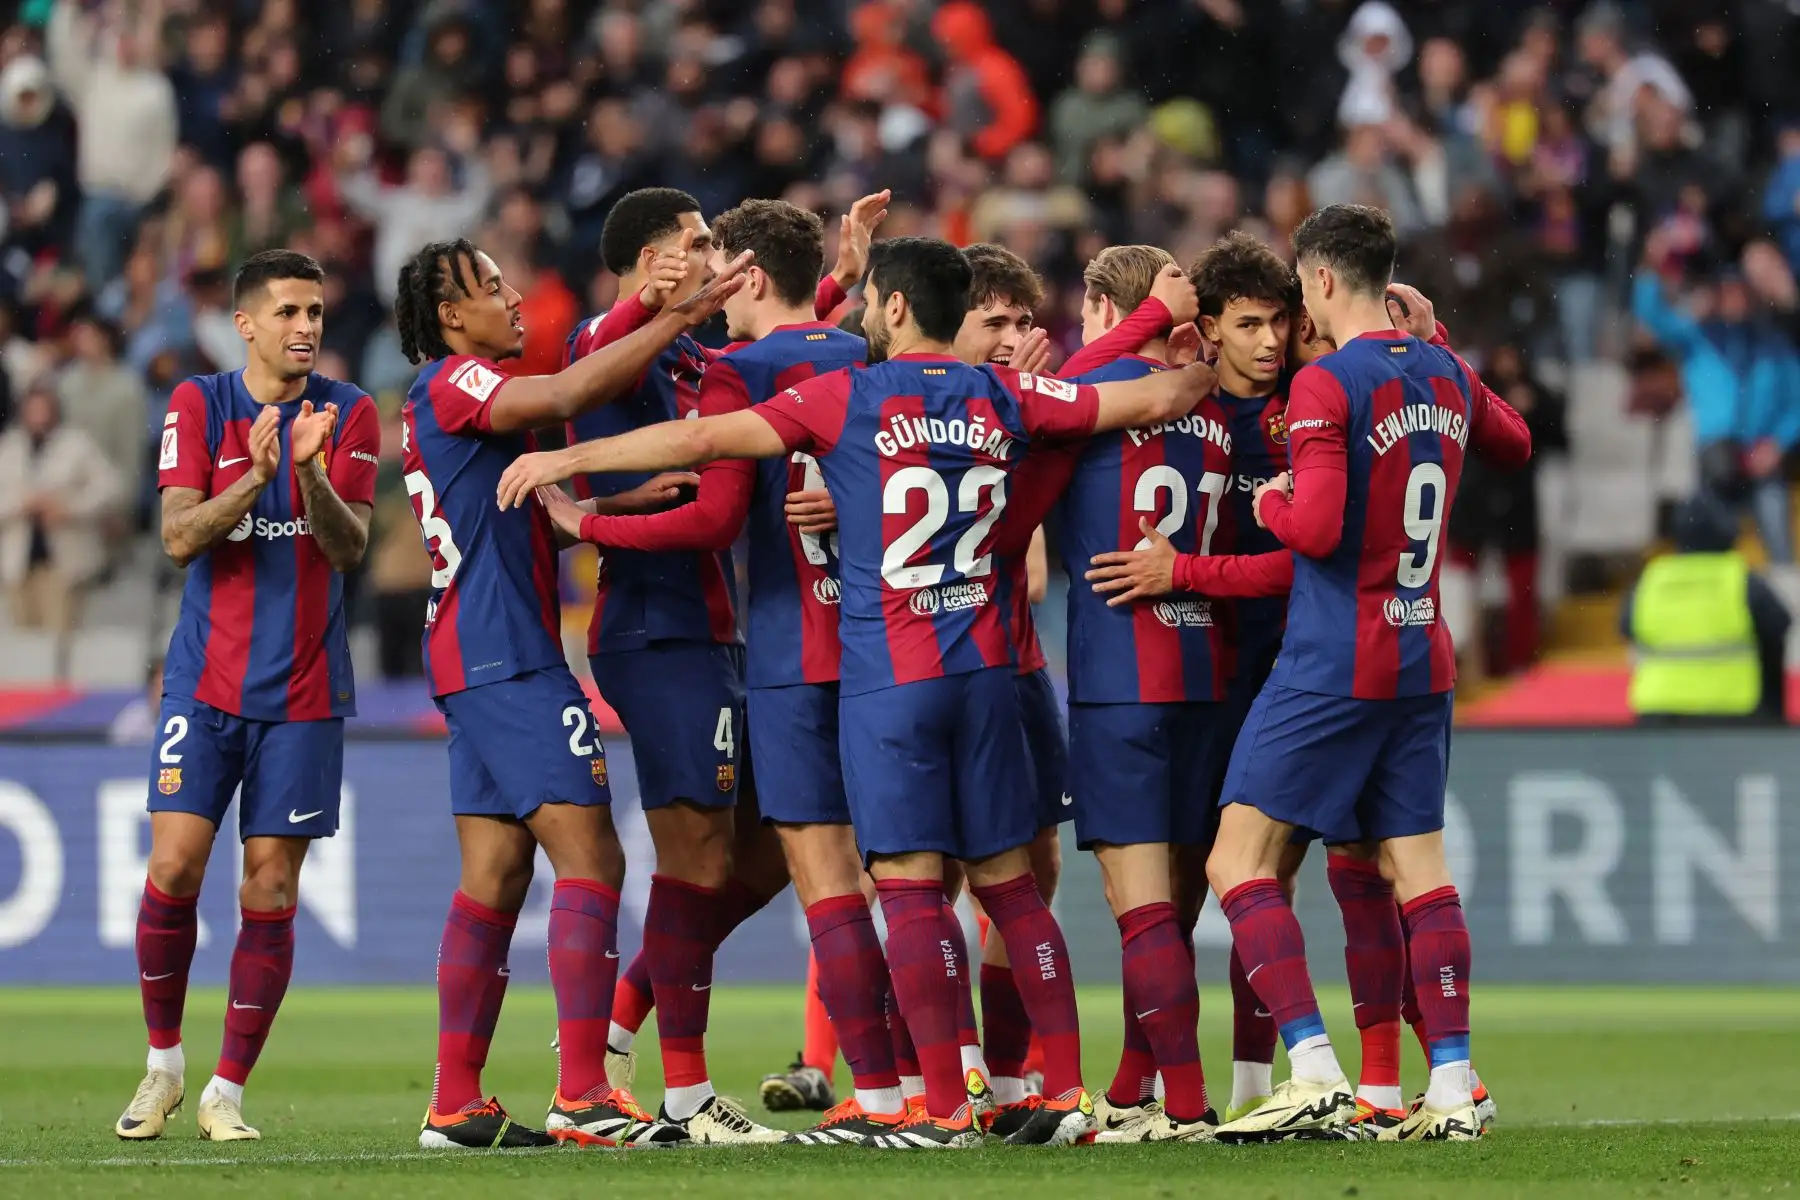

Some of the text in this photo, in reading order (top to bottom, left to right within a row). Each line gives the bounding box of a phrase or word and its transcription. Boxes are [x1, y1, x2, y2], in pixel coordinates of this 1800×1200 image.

[255, 515, 312, 541] Spoti
[880, 466, 1008, 589] 22
[1396, 462, 1447, 588] 9
[941, 582, 985, 598] UNHCR
[943, 592, 989, 608] ACNUR
[159, 715, 189, 764] 2
[713, 707, 735, 759] 4
[1443, 769, 1782, 947] RN
[940, 939, 958, 977] BARÇA
[1035, 941, 1057, 981] BARÇA
[1439, 965, 1458, 998] BARÇA
